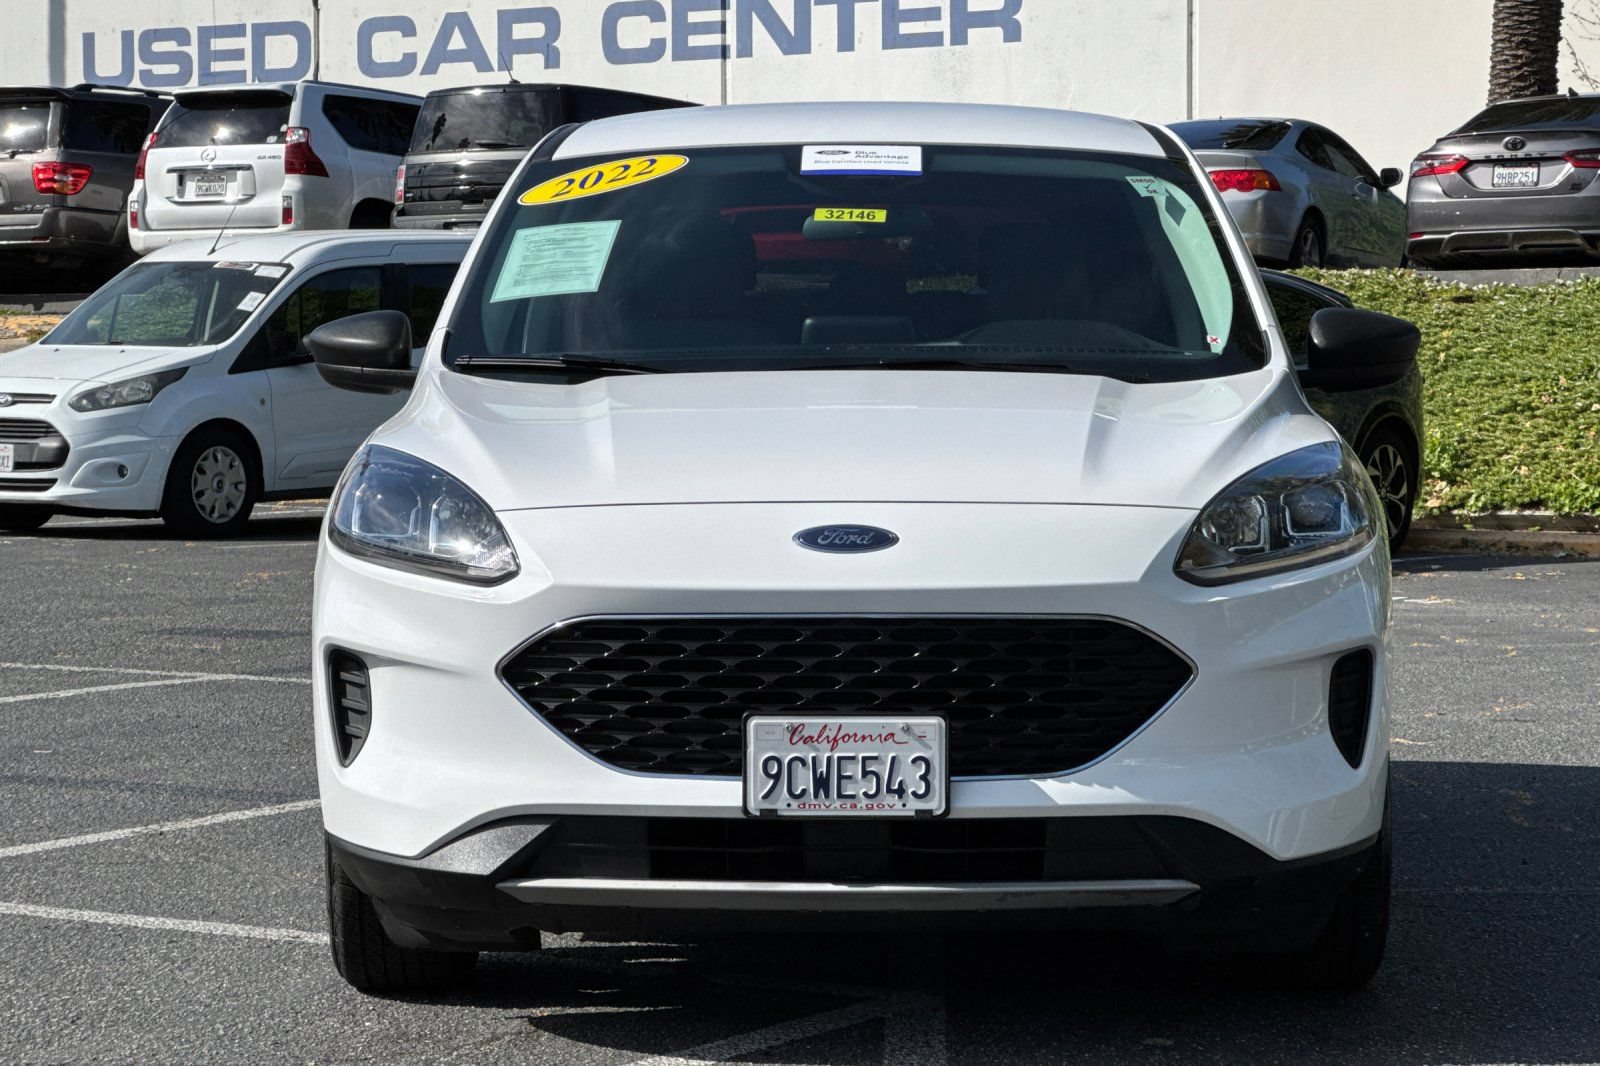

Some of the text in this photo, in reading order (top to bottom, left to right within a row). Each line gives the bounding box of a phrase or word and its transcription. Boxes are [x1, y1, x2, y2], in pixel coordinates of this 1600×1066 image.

[82, 0, 1022, 87] USED CAR CENTER
[551, 158, 657, 198] 2022
[824, 209, 876, 220] 32146
[817, 527, 875, 545] Ford
[789, 723, 909, 752] California
[760, 755, 931, 800] 9CWE543
[797, 802, 897, 811] dmv.ca.gov
